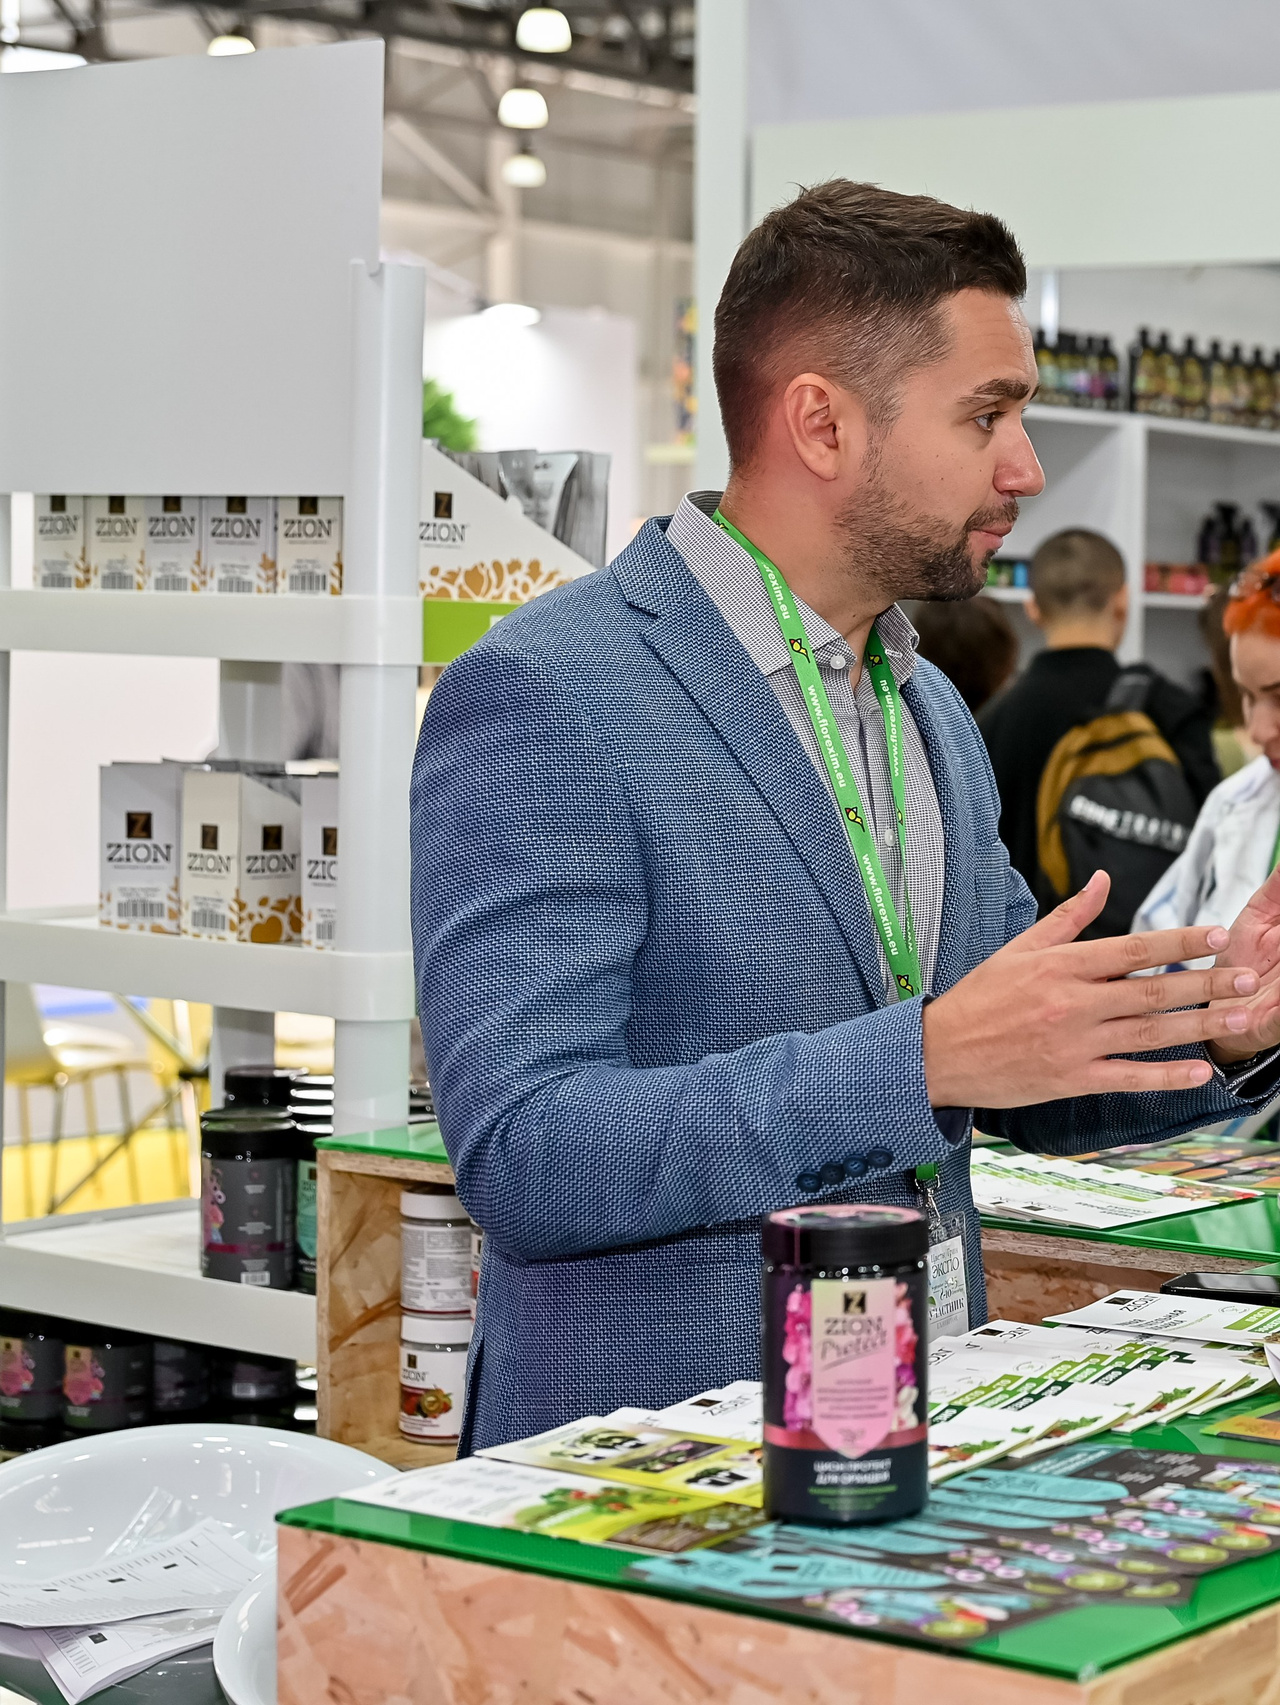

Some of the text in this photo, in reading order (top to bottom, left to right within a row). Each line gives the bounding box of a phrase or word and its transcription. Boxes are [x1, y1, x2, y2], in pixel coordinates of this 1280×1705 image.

[38, 514, 78, 535] ZION
[96, 516, 138, 537] ZION
[149, 515, 196, 537] ZION
[211, 516, 262, 539] ZION
[283, 517, 332, 539] ZION
[419, 521, 467, 543] ZION
[807, 684, 847, 787] www.florexim.eu
[880, 679, 899, 777] www.florexim.eu
[106, 842, 173, 864] ZION
[187, 852, 232, 874] ZION
[246, 852, 298, 875] ZION
[307, 859, 338, 881] ZIO
[862, 853, 899, 956] www.florexim.eu
[931, 1257, 960, 1279] ЭКСПО
[1119, 1294, 1159, 1312] ZION
[823, 1315, 884, 1336] ZION
